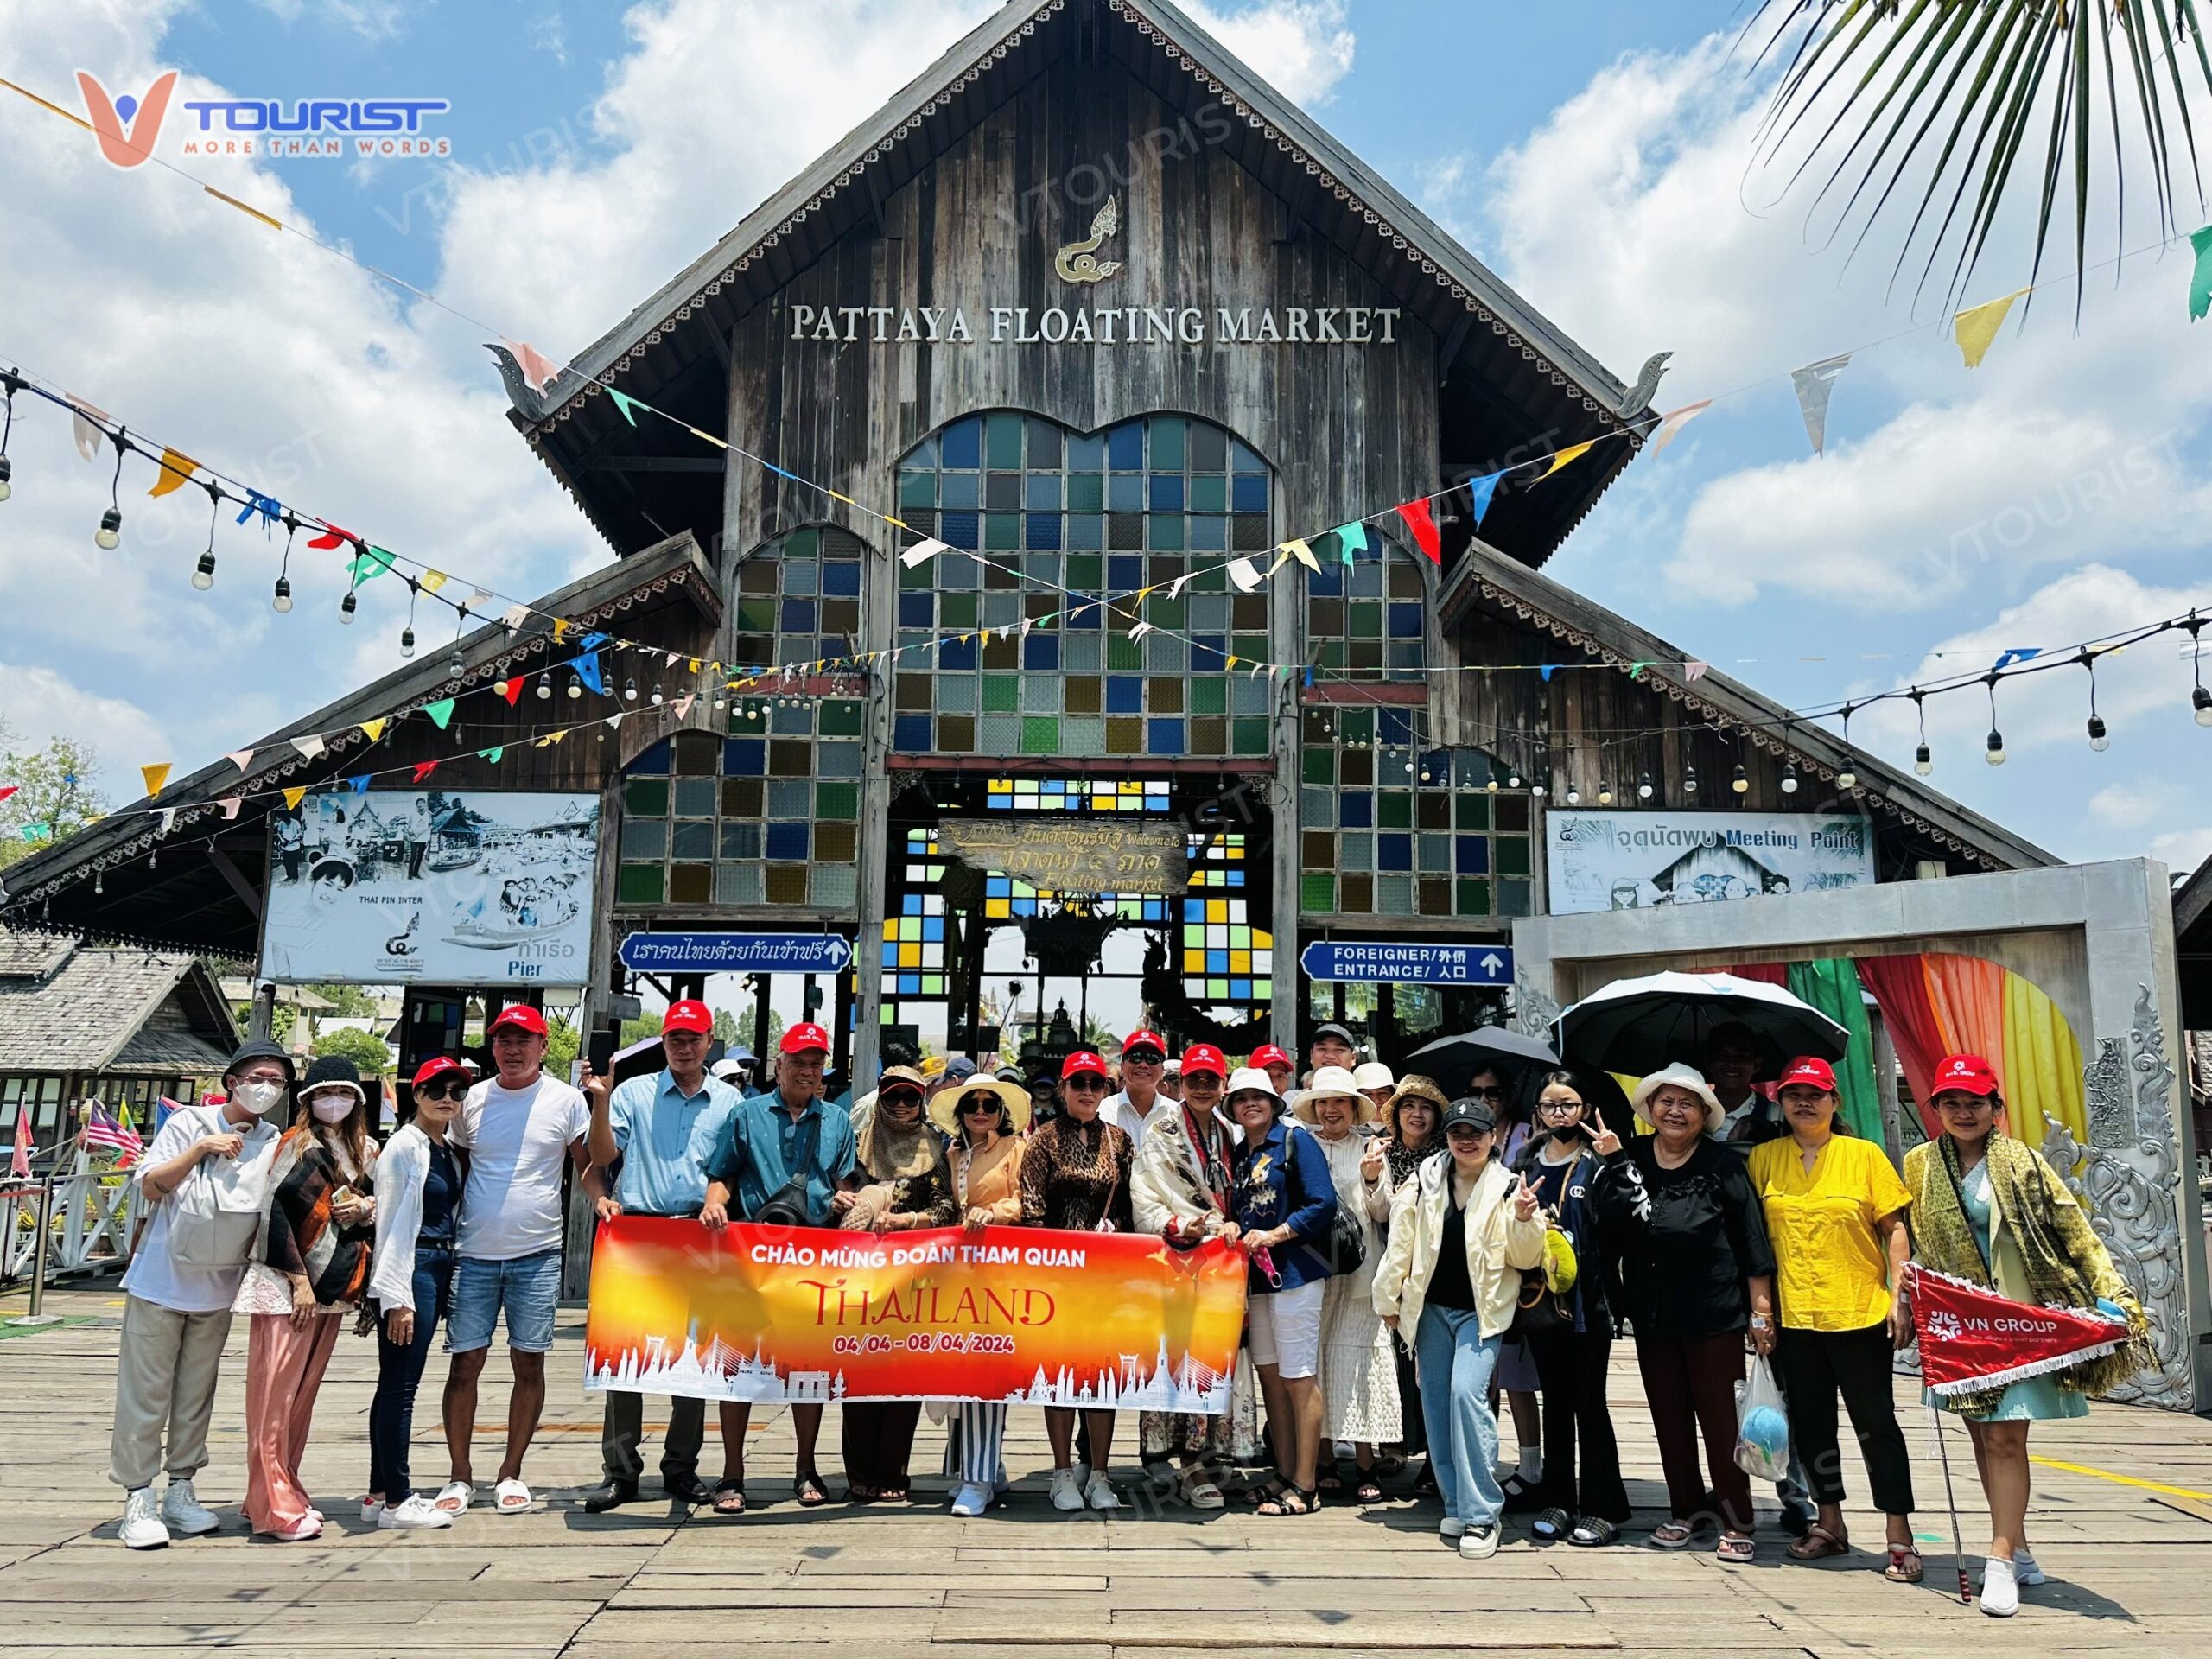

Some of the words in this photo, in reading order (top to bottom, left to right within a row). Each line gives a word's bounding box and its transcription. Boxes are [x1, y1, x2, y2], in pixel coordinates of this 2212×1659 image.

[791, 305, 974, 344] PATTAYA
[989, 307, 1205, 345] FLOATING
[1217, 307, 1401, 344] MARKET
[1726, 830, 1798, 850] Meeting
[1810, 831, 1859, 849] Point
[1039, 870, 1107, 892] Floating
[1110, 874, 1166, 893] market
[359, 896, 378, 905] THAI
[381, 896, 396, 905] PIN
[397, 896, 423, 905] INTER
[508, 961, 543, 976] Pier
[1439, 965, 1467, 979] 入口
[751, 1242, 815, 1267] CHÀO
[821, 1244, 886, 1268] MỪNG
[892, 1243, 955, 1266] ĐOÀN
[960, 1245, 1019, 1265] THAM
[1024, 1248, 1086, 1268] QUAN
[797, 1278, 1056, 1326] THAILAND
[1963, 1318, 1990, 1331] VN
[1994, 1318, 2058, 1333] GROUP
[833, 1335, 891, 1354] 04/04
[906, 1333, 1015, 1354] 08/04/2024
